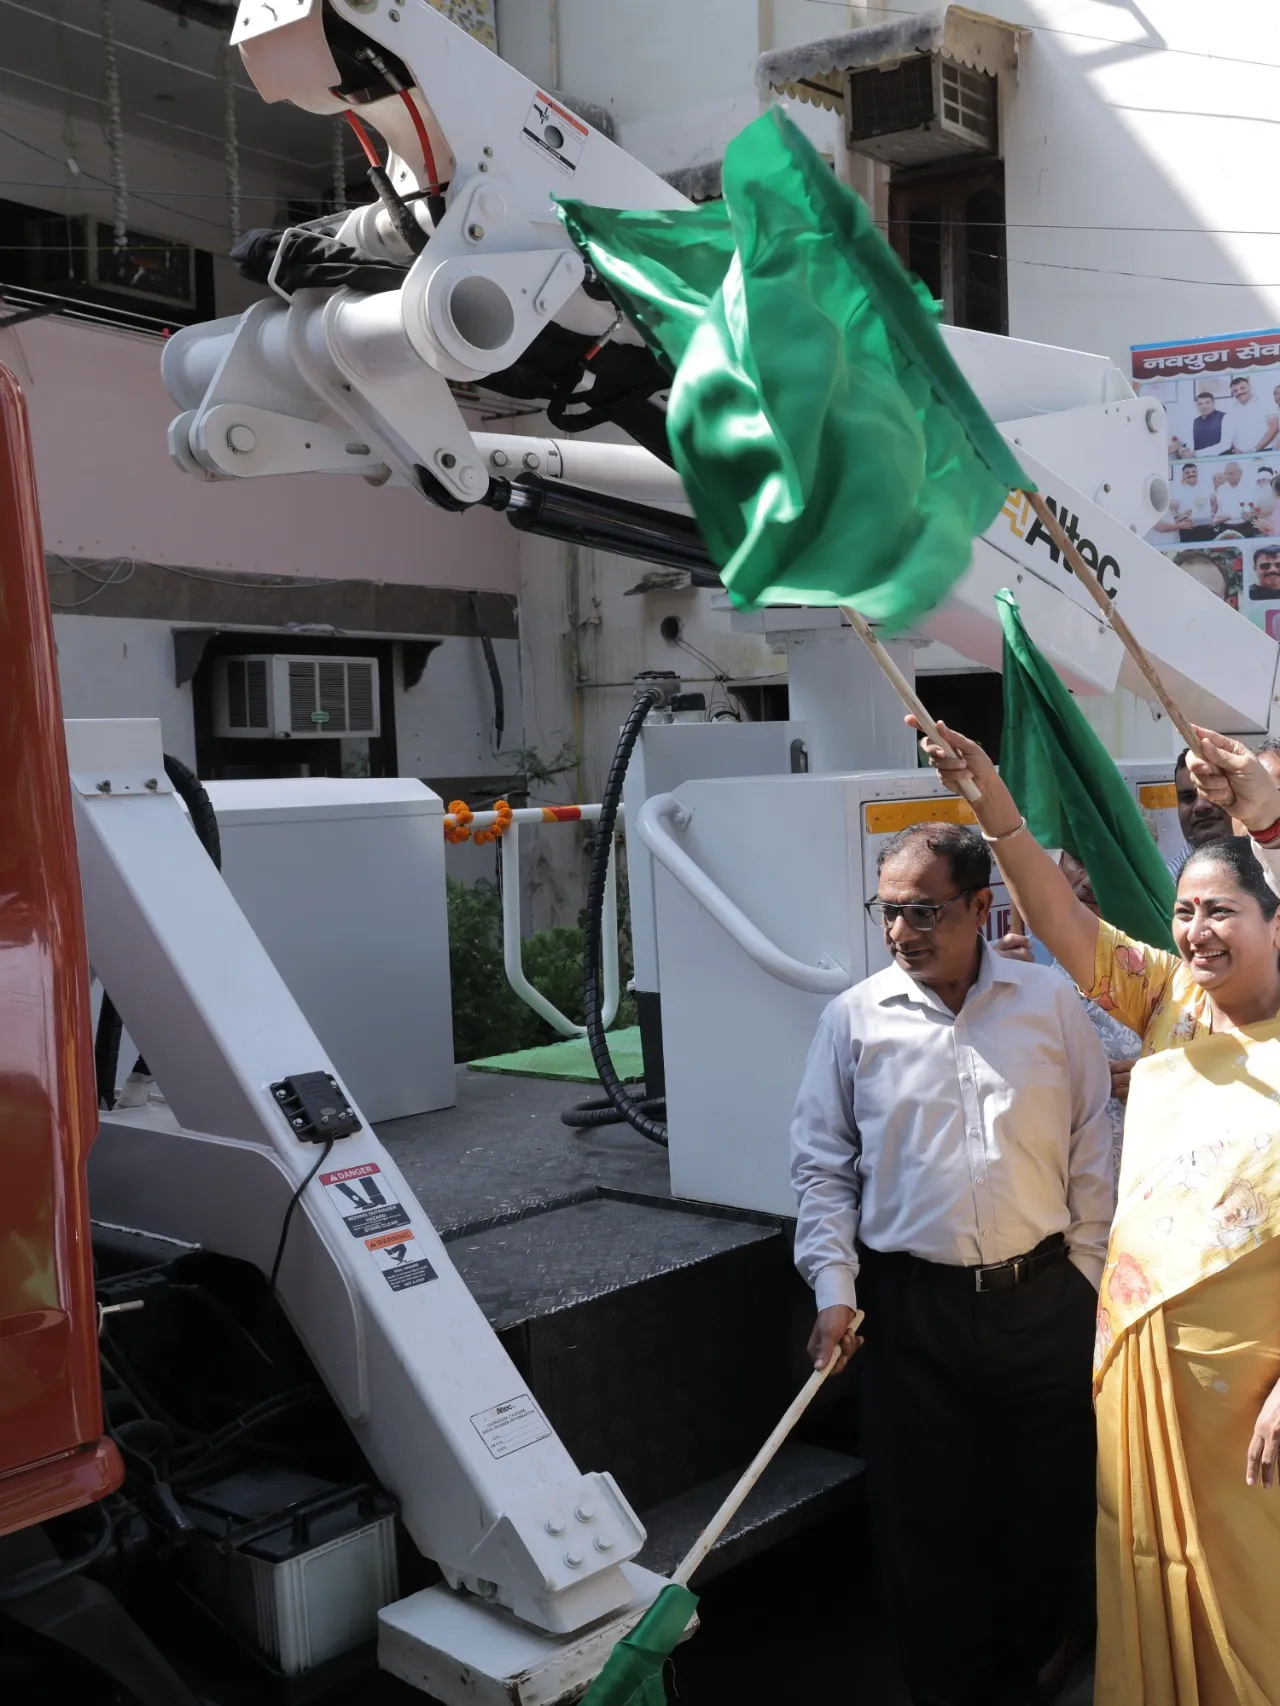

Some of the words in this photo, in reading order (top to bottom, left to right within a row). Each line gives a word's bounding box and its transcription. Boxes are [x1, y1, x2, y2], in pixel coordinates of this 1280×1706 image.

[1143, 349, 1229, 369] नवयुग
[337, 1166, 373, 1180] DANGER
[377, 1232, 410, 1246] WARNING
